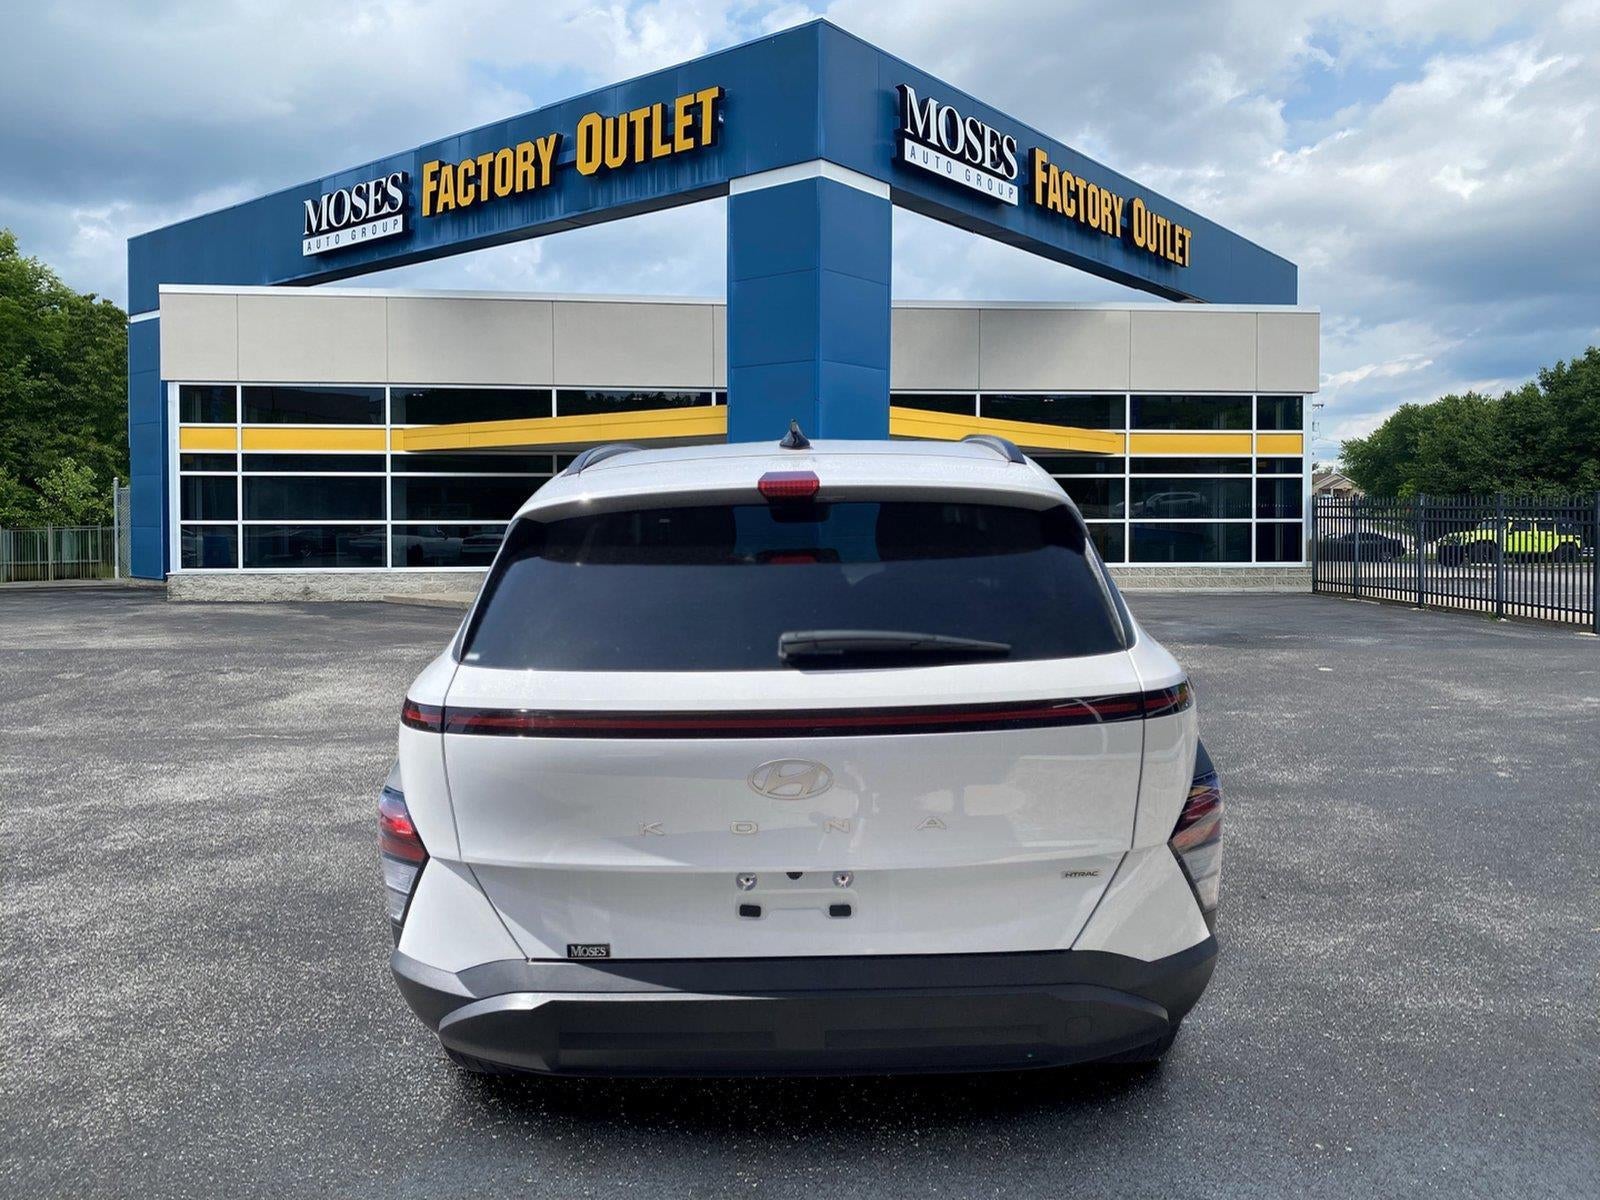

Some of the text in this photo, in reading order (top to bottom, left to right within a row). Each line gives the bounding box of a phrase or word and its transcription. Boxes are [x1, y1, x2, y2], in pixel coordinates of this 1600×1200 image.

[422, 86, 720, 217] FACTORY OUTLET
[903, 84, 1018, 180] MOSES
[303, 171, 403, 235] MOSES
[909, 144, 1015, 199] AUTO GROUP
[306, 218, 400, 252] AUTO GROUP
[1034, 147, 1192, 267] FACTORY OUTLET
[571, 945, 606, 957] MOSES
